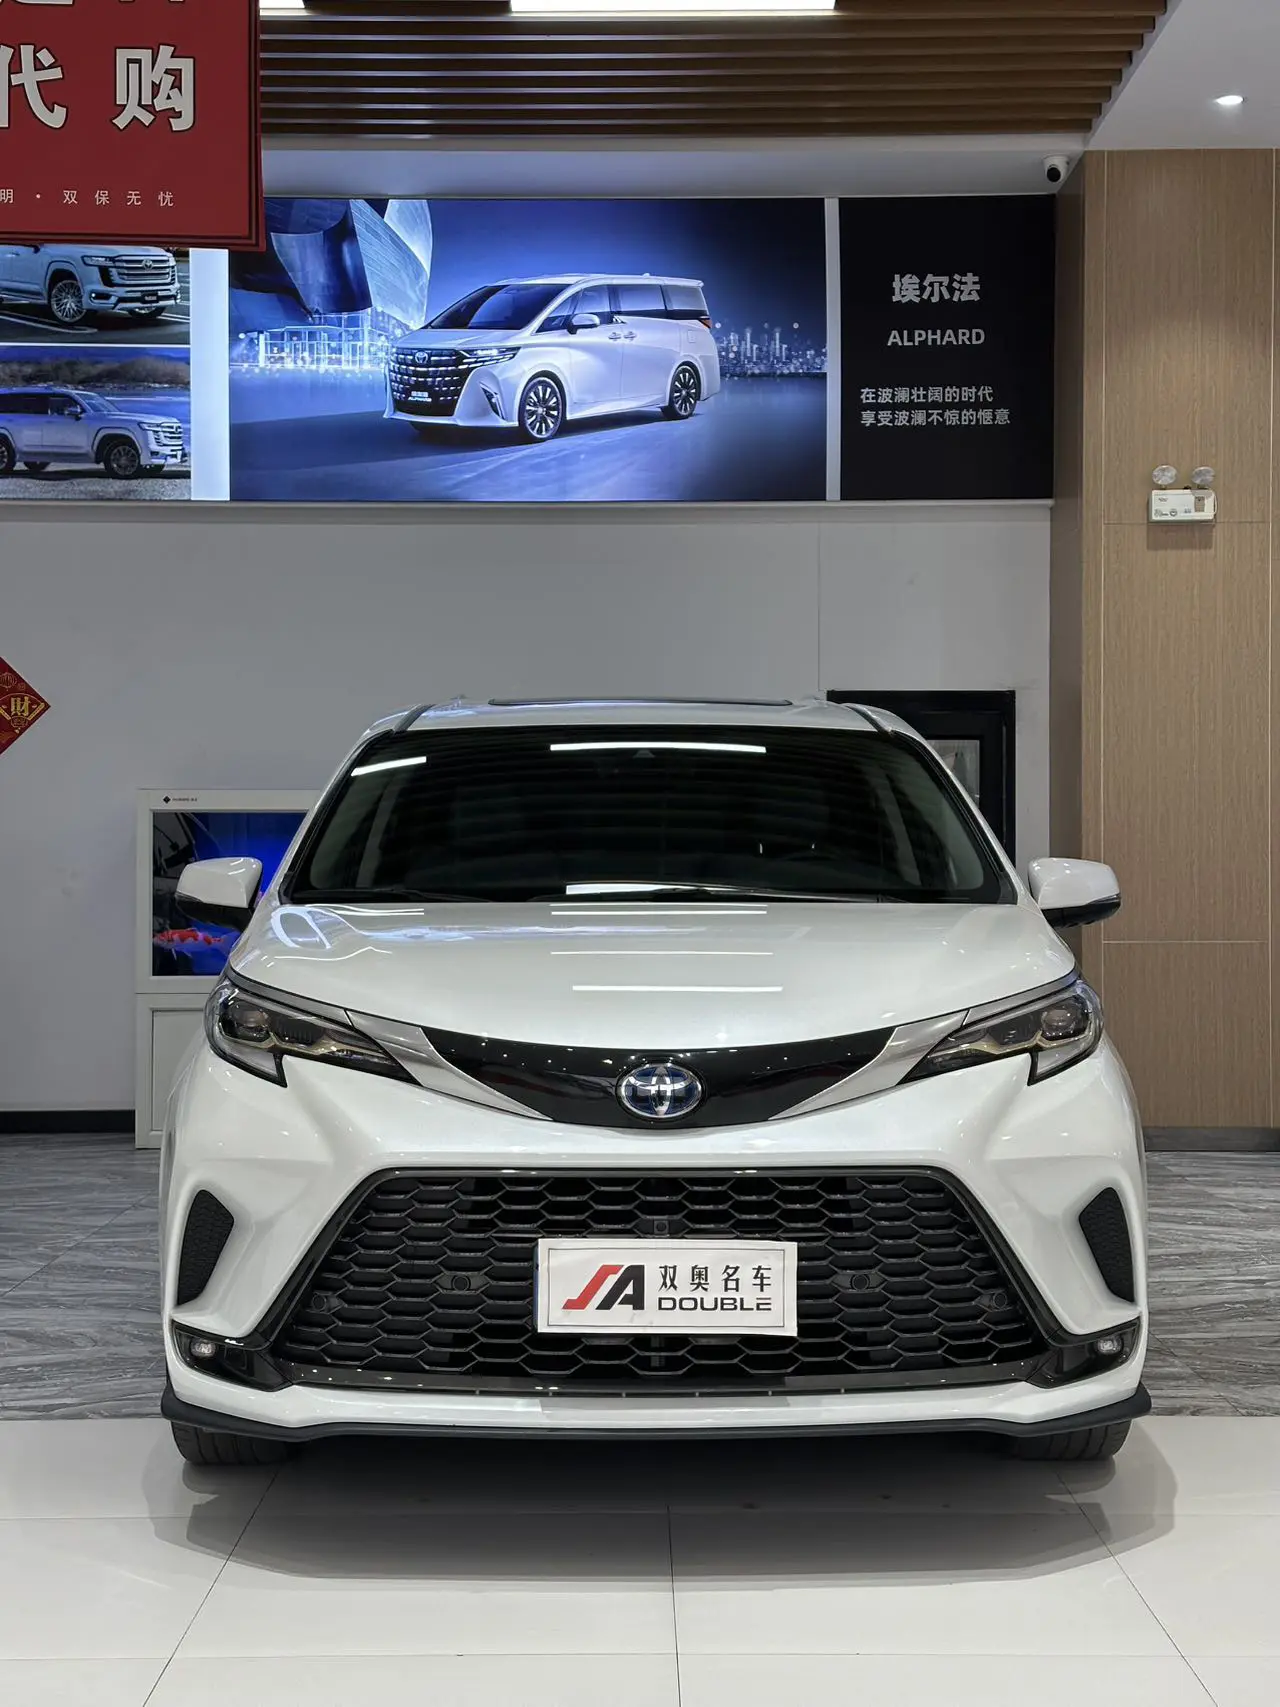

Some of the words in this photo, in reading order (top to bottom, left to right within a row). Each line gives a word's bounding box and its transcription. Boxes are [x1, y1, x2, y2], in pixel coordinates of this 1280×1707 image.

[0, 44, 196, 132] 代购
[892, 272, 980, 302] 埃尔法
[887, 328, 985, 345] ALPHARD
[860, 386, 993, 403] 在波澜壮阔的时代
[860, 408, 1010, 426] 享受波澜不惊的惬意
[658, 1265, 772, 1293] 双奥名车
[658, 1297, 772, 1311] DOUBLE
